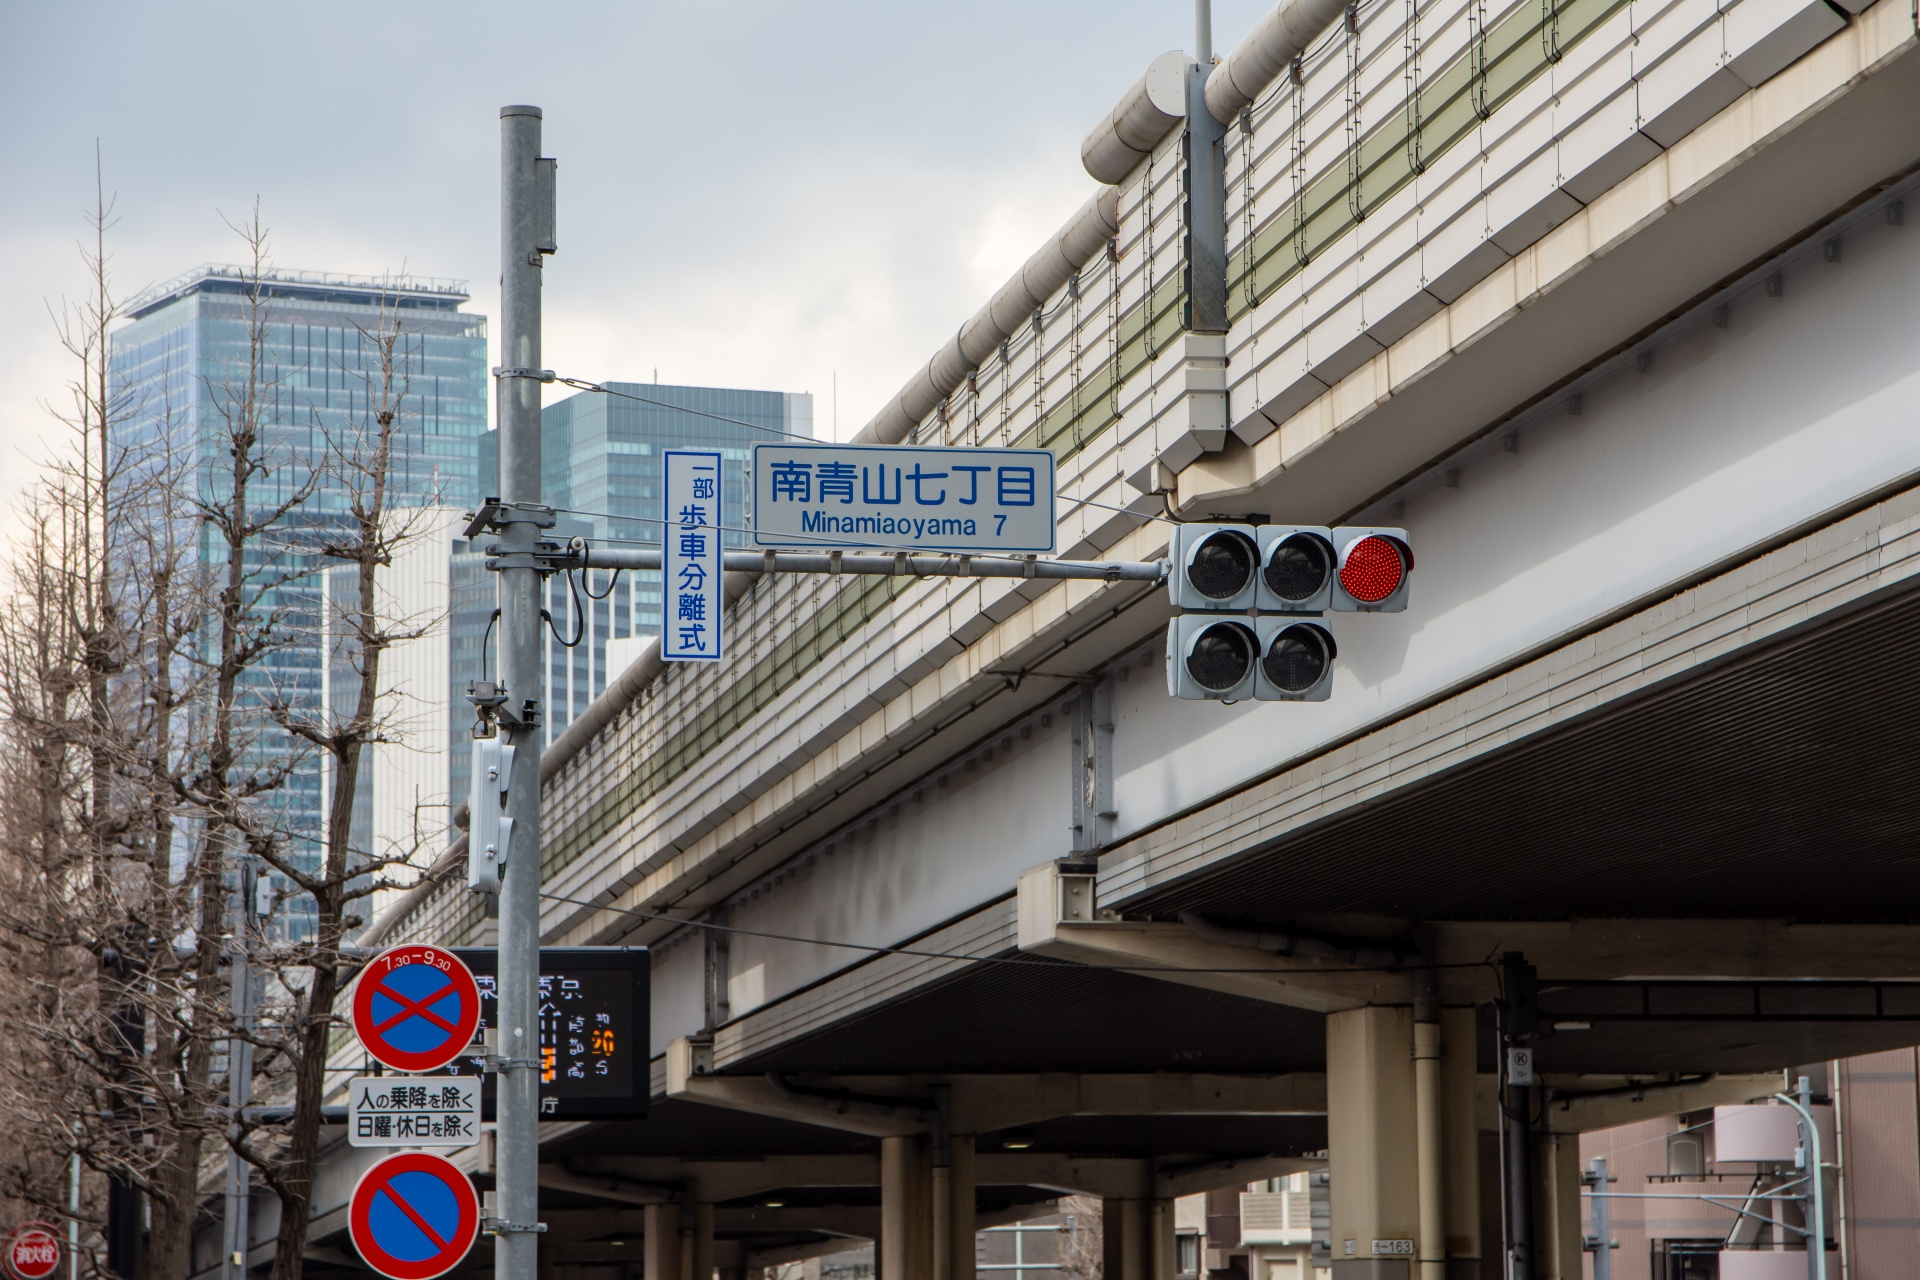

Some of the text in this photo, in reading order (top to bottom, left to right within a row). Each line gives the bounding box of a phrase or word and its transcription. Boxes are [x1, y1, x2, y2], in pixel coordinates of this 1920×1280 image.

[770, 459, 1035, 506] 南青山七丁目
[801, 510, 1007, 539] Minamiaoyama 7
[357, 1086, 473, 1110] 人の乗降を除く
